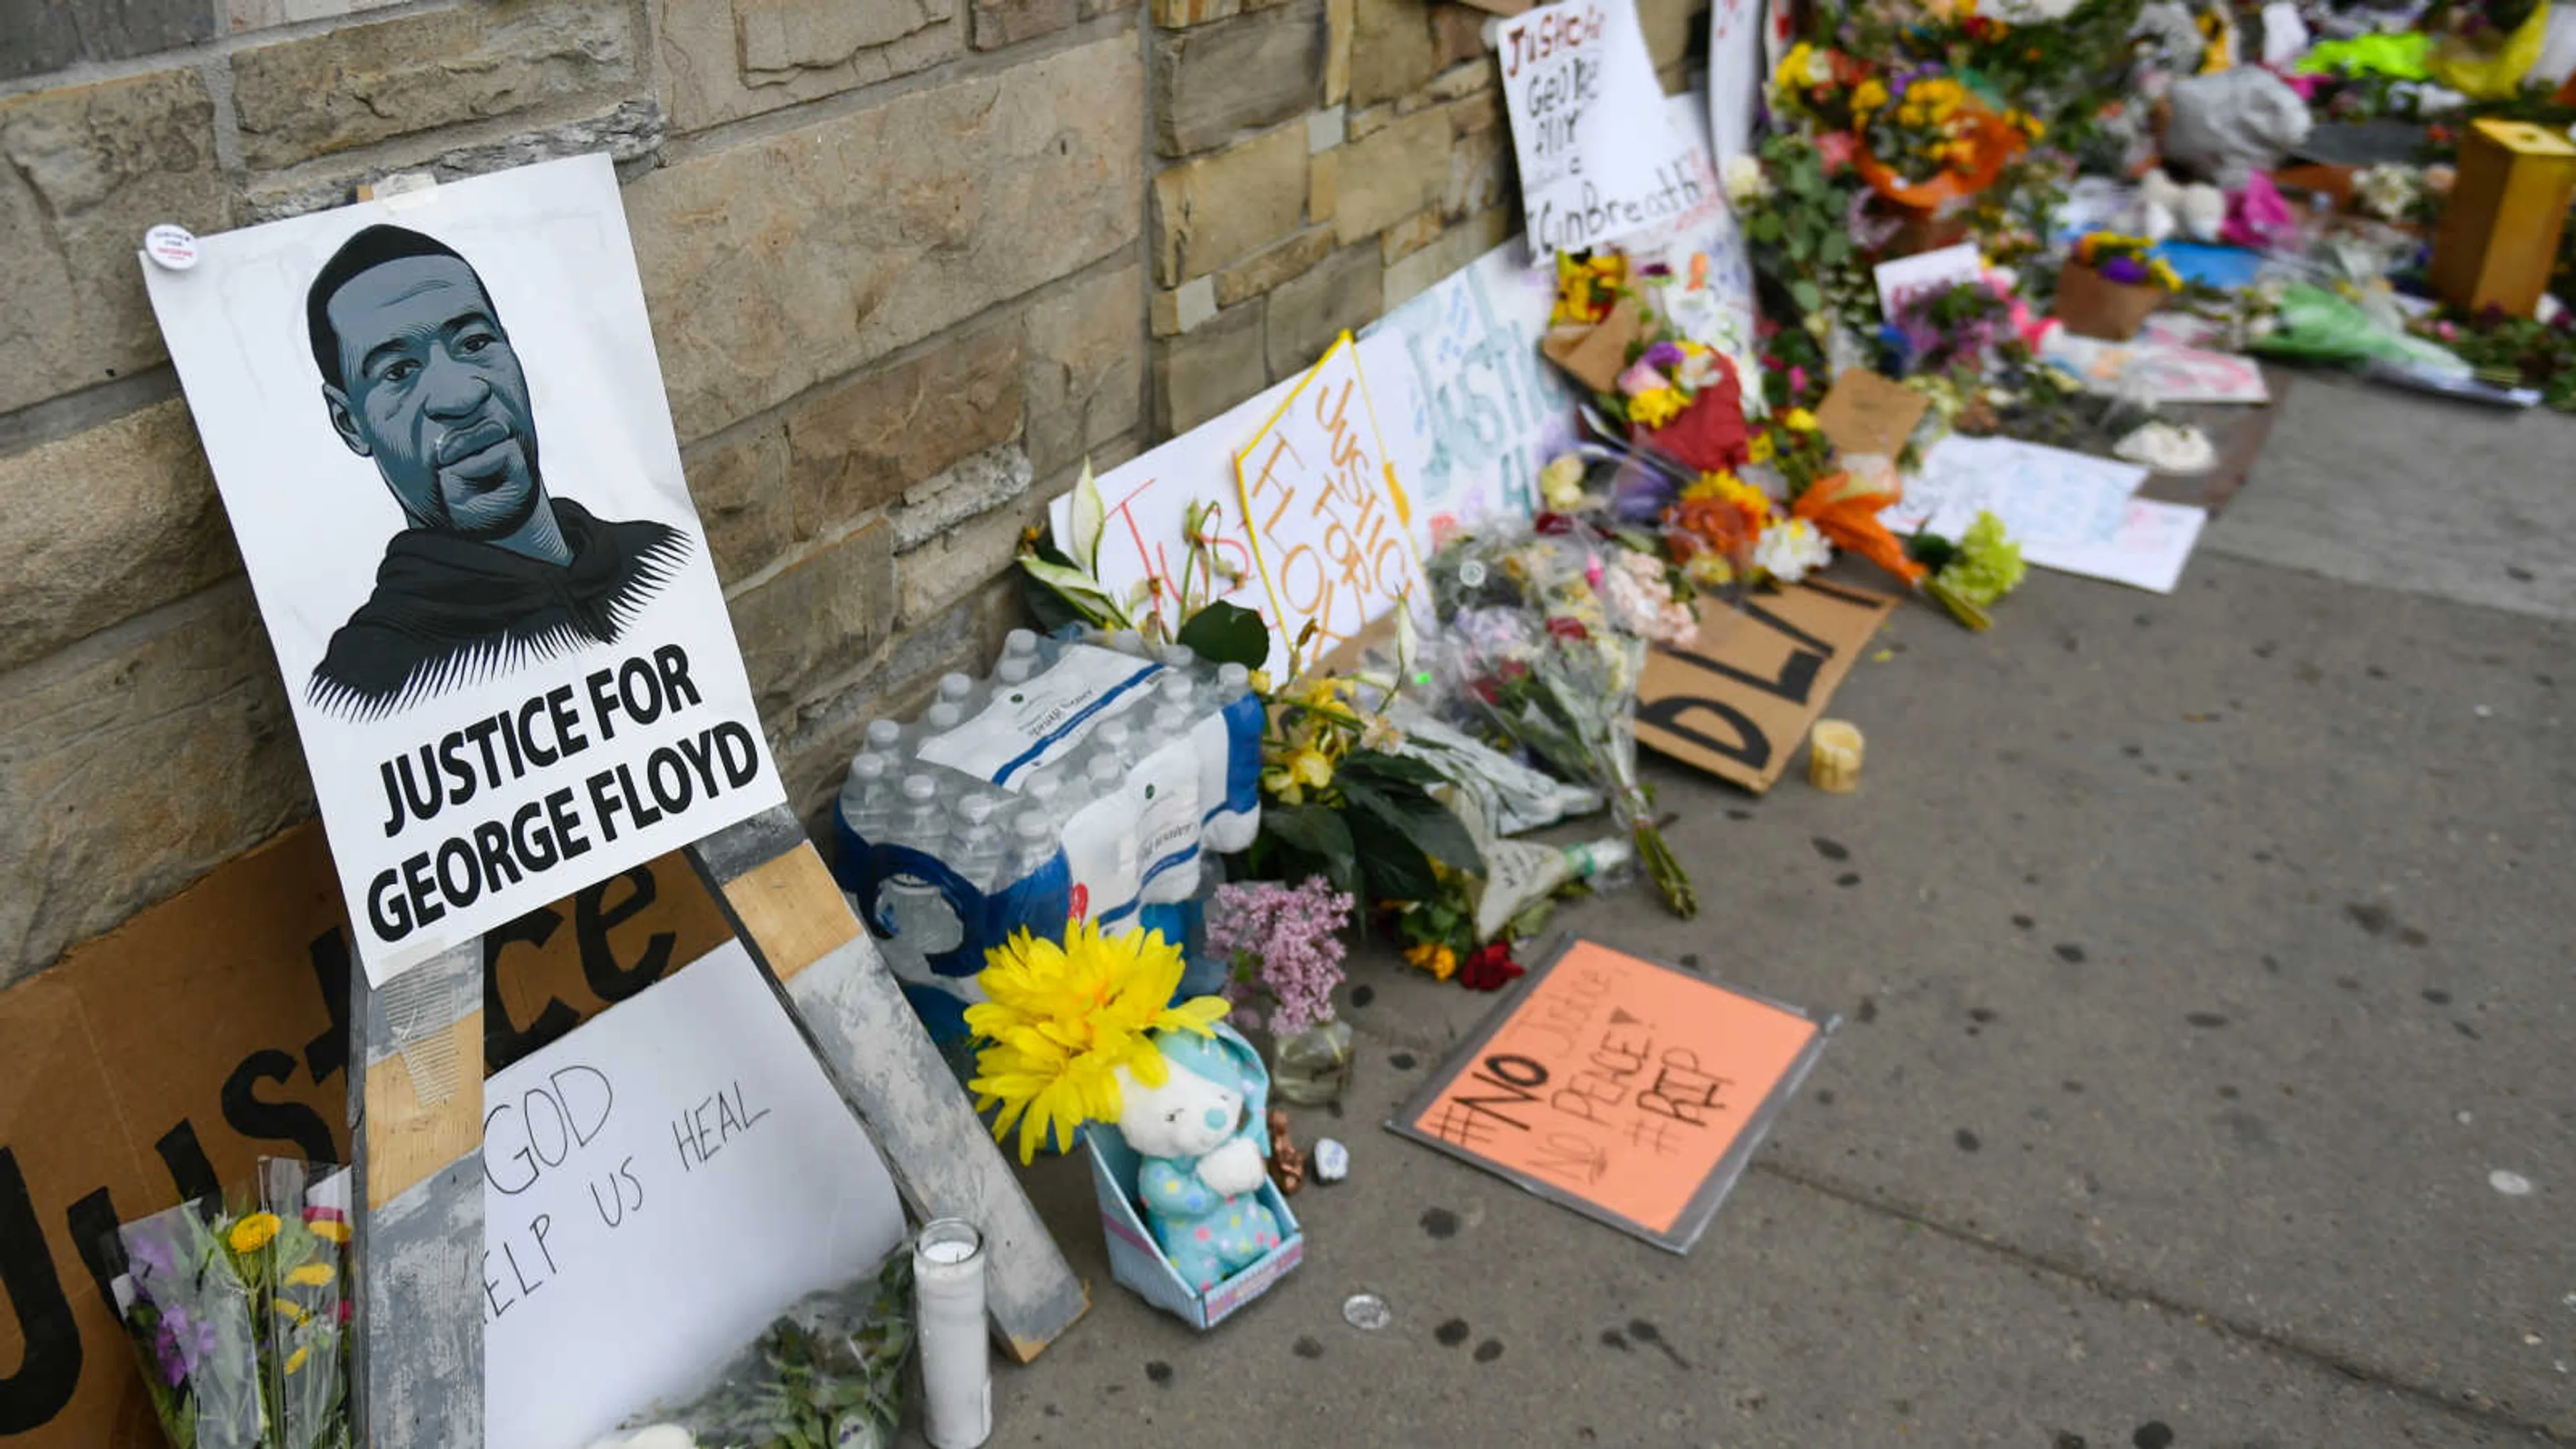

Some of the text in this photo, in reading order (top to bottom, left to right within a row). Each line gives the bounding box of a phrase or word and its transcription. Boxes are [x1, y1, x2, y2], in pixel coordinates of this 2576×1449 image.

[379, 643, 702, 838] JUSTICE FOR
[366, 720, 759, 943] GEORGE FLOYD
[483, 1065, 613, 1195] GOD
[1425, 1053, 1550, 1146] #NO
[1524, 1132, 1598, 1183] NO
[483, 1081, 771, 1326] ELP US HEAL
